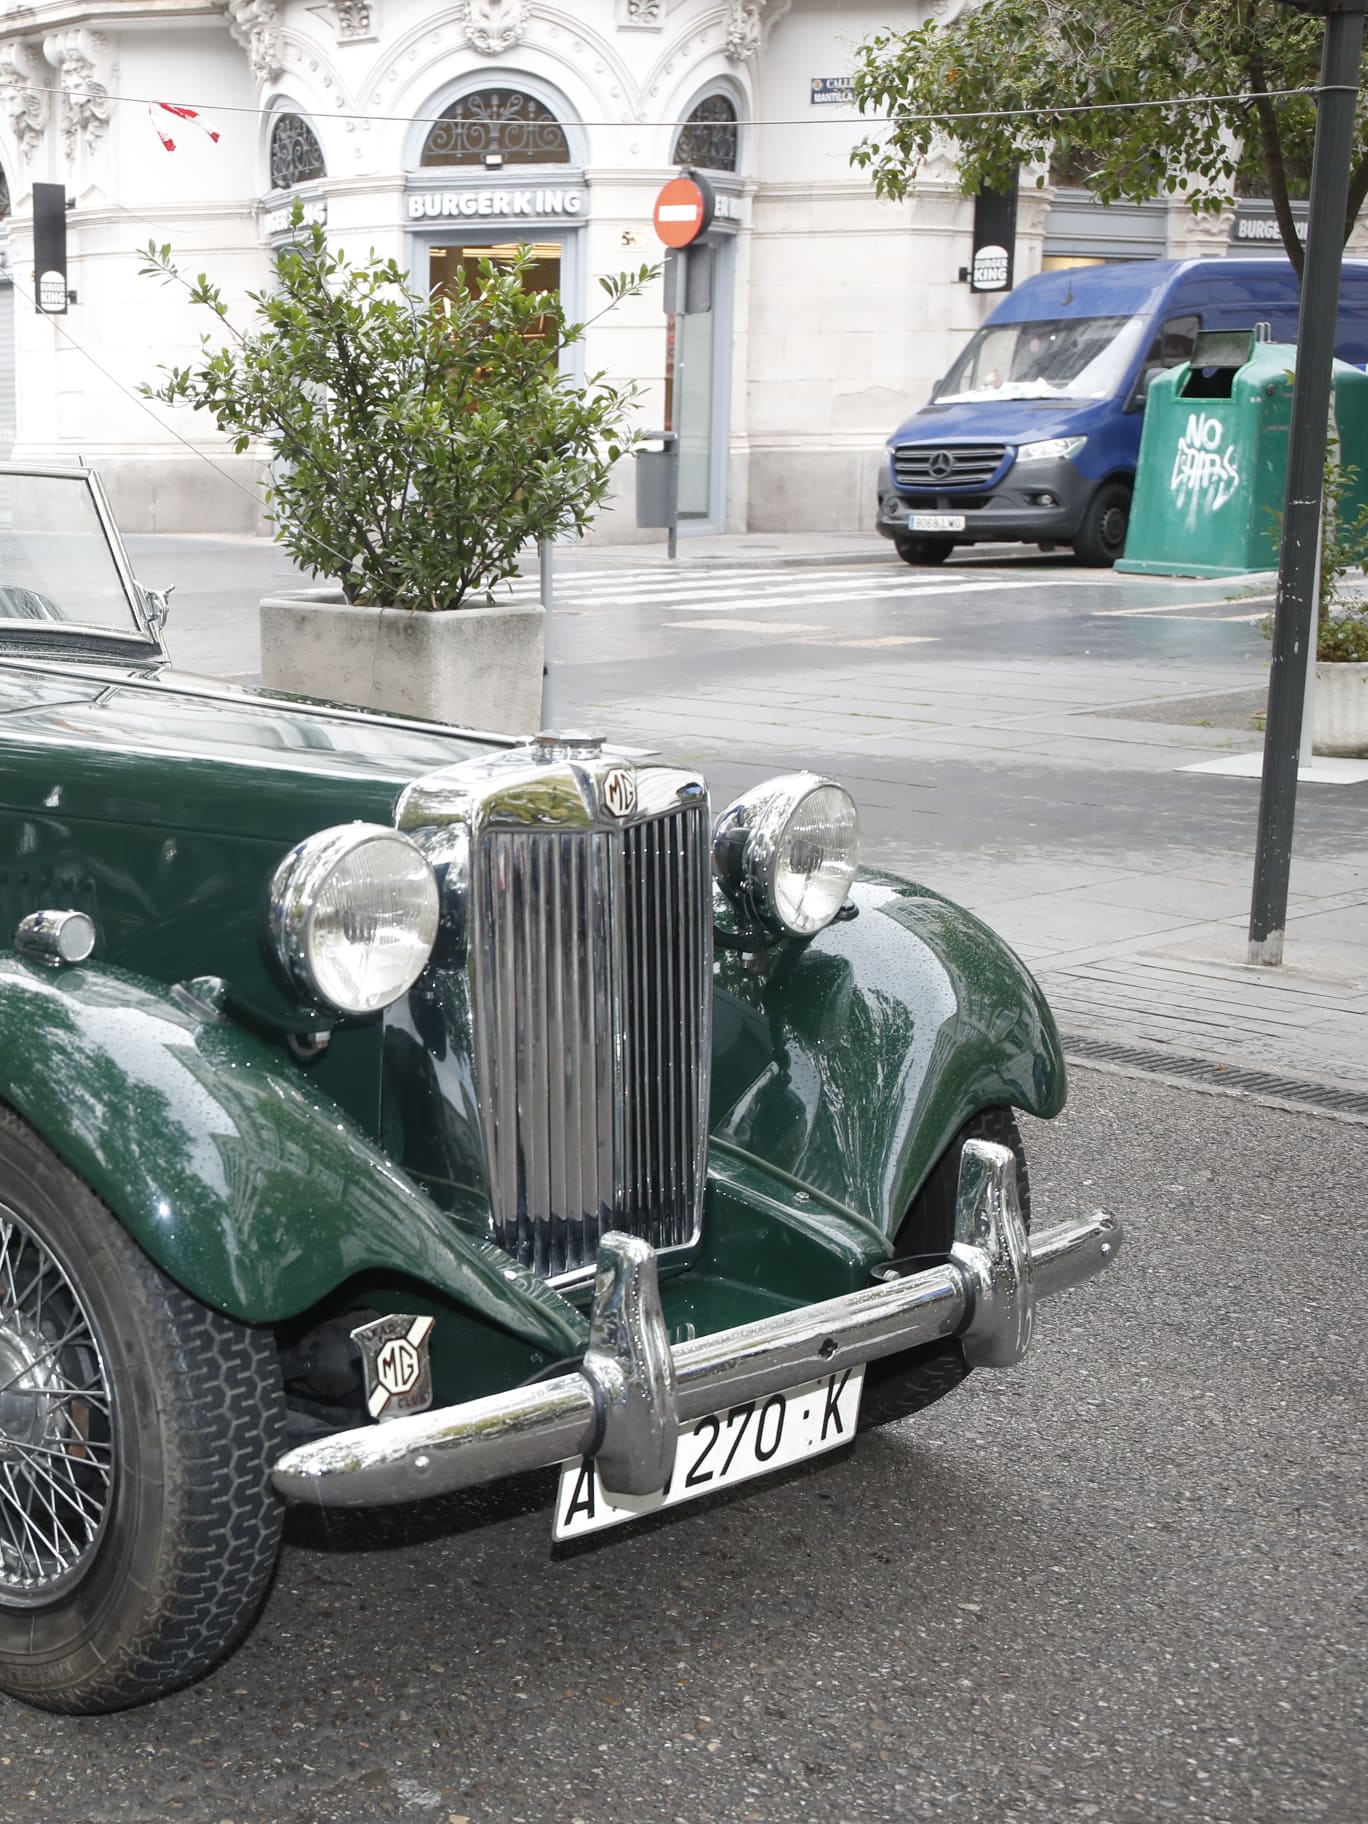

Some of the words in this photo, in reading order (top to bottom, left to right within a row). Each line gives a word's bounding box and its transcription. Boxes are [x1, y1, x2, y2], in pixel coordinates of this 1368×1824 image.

[408, 192, 510, 218] BURGER
[514, 190, 581, 214] KING
[1238, 220, 1282, 239] BURGE
[974, 267, 1008, 281] KING
[40, 291, 65, 303] KING
[1186, 411, 1223, 450] NO
[382, 1345, 415, 1387] MG
